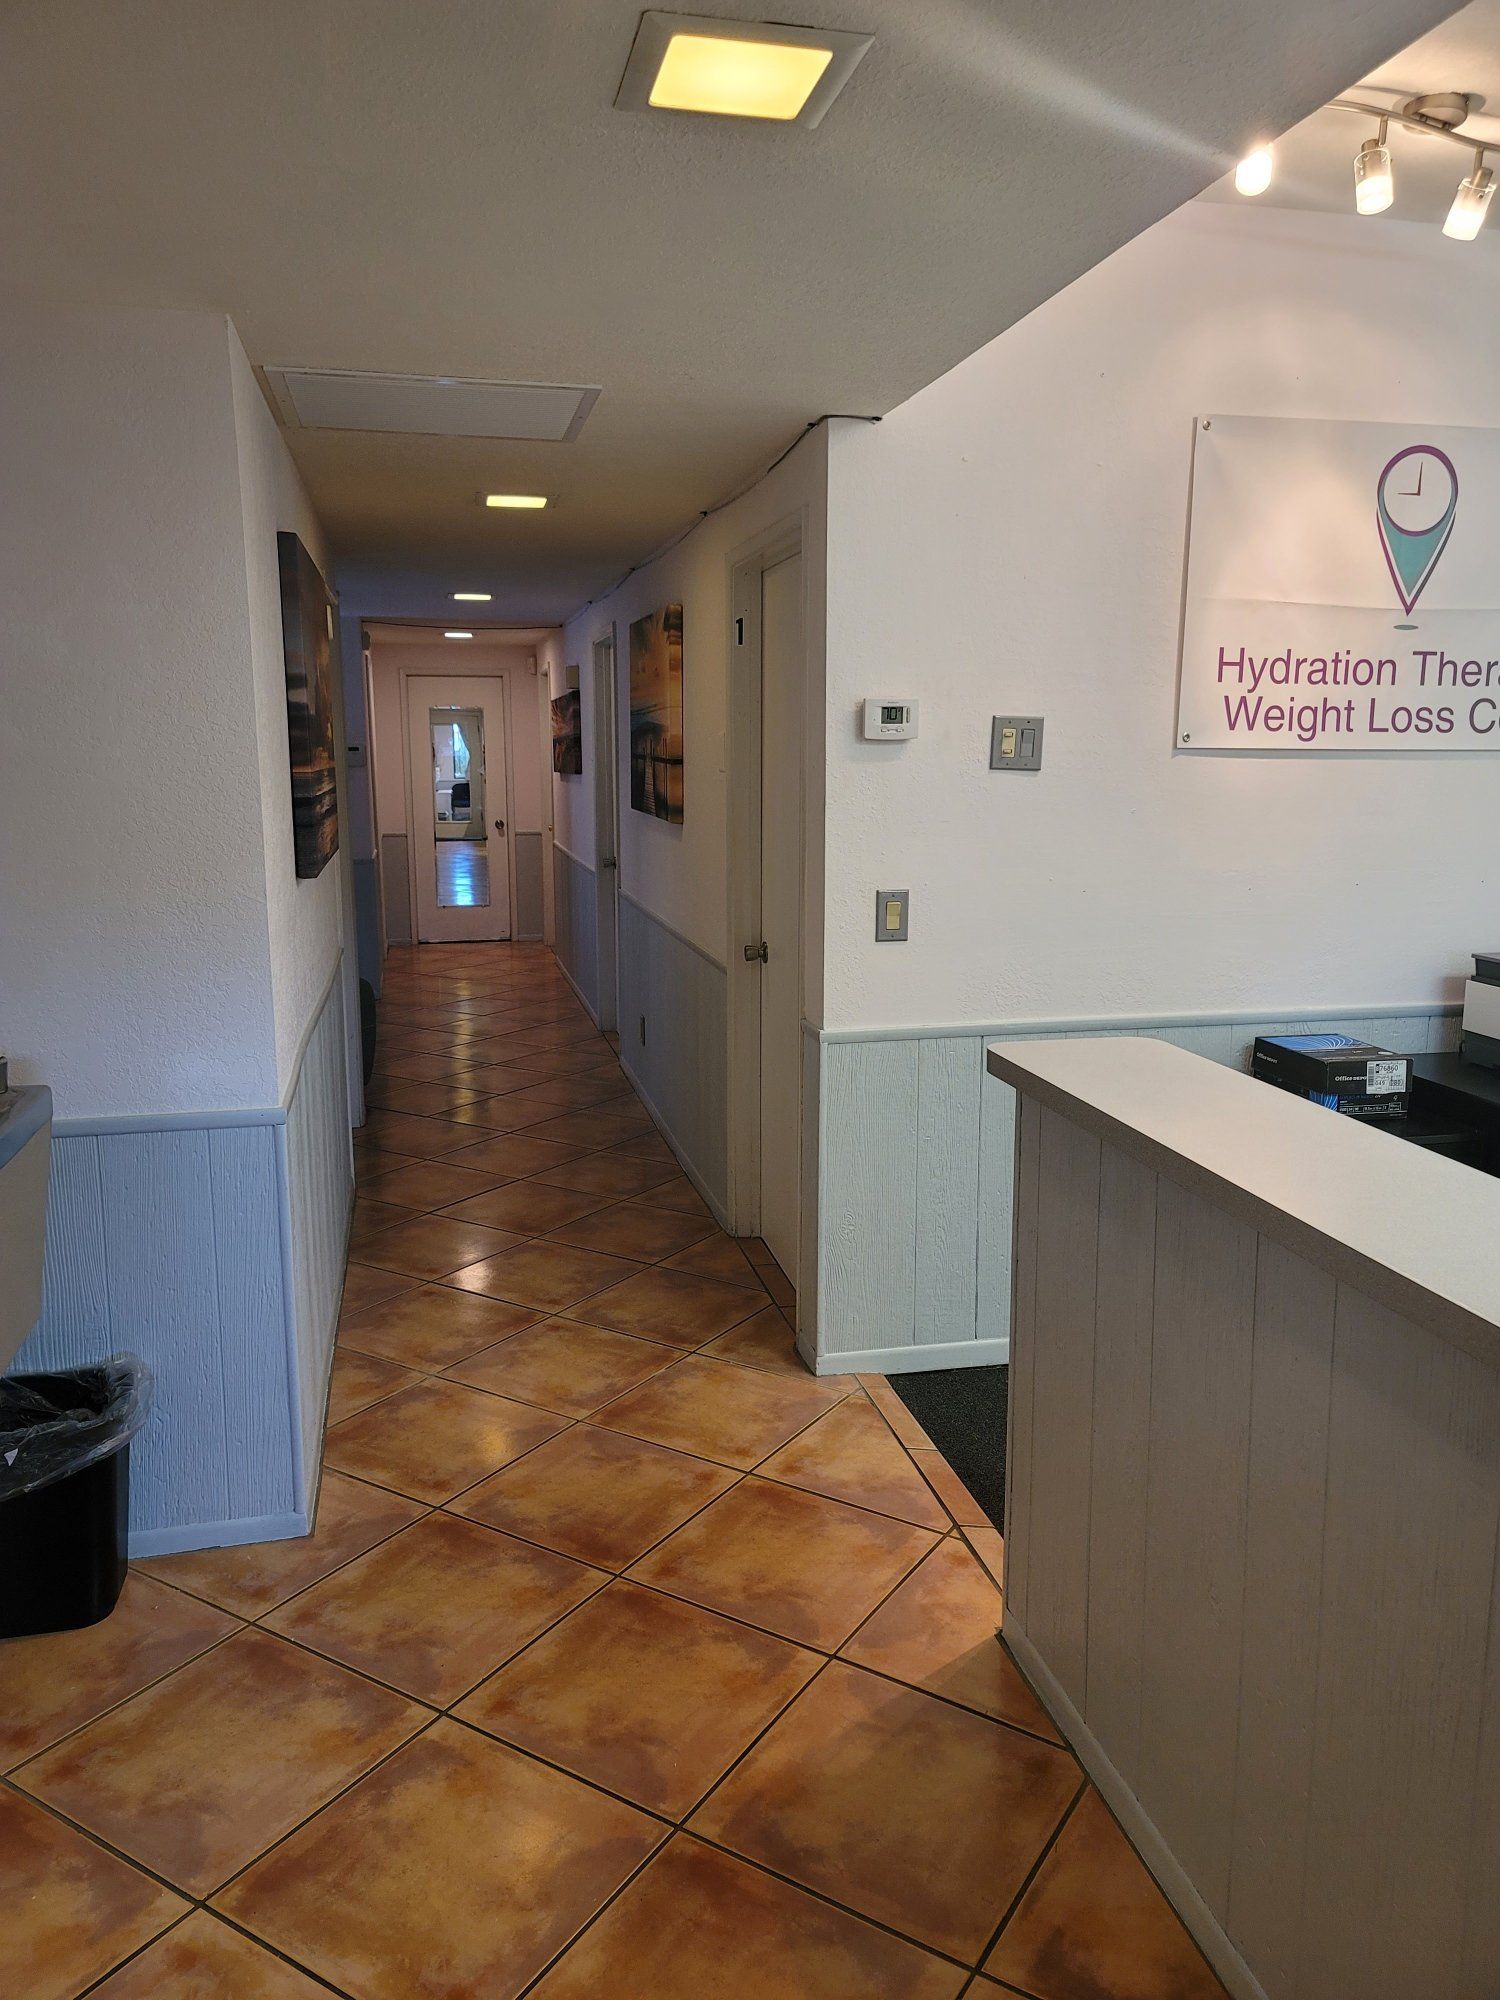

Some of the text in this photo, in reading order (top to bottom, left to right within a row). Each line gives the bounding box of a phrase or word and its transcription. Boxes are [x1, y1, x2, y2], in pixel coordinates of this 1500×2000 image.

[735, 617, 744, 646] 1
[1217, 646, 1500, 694] Hydration Ther
[1223, 695, 1500, 742] Weight Loss C
